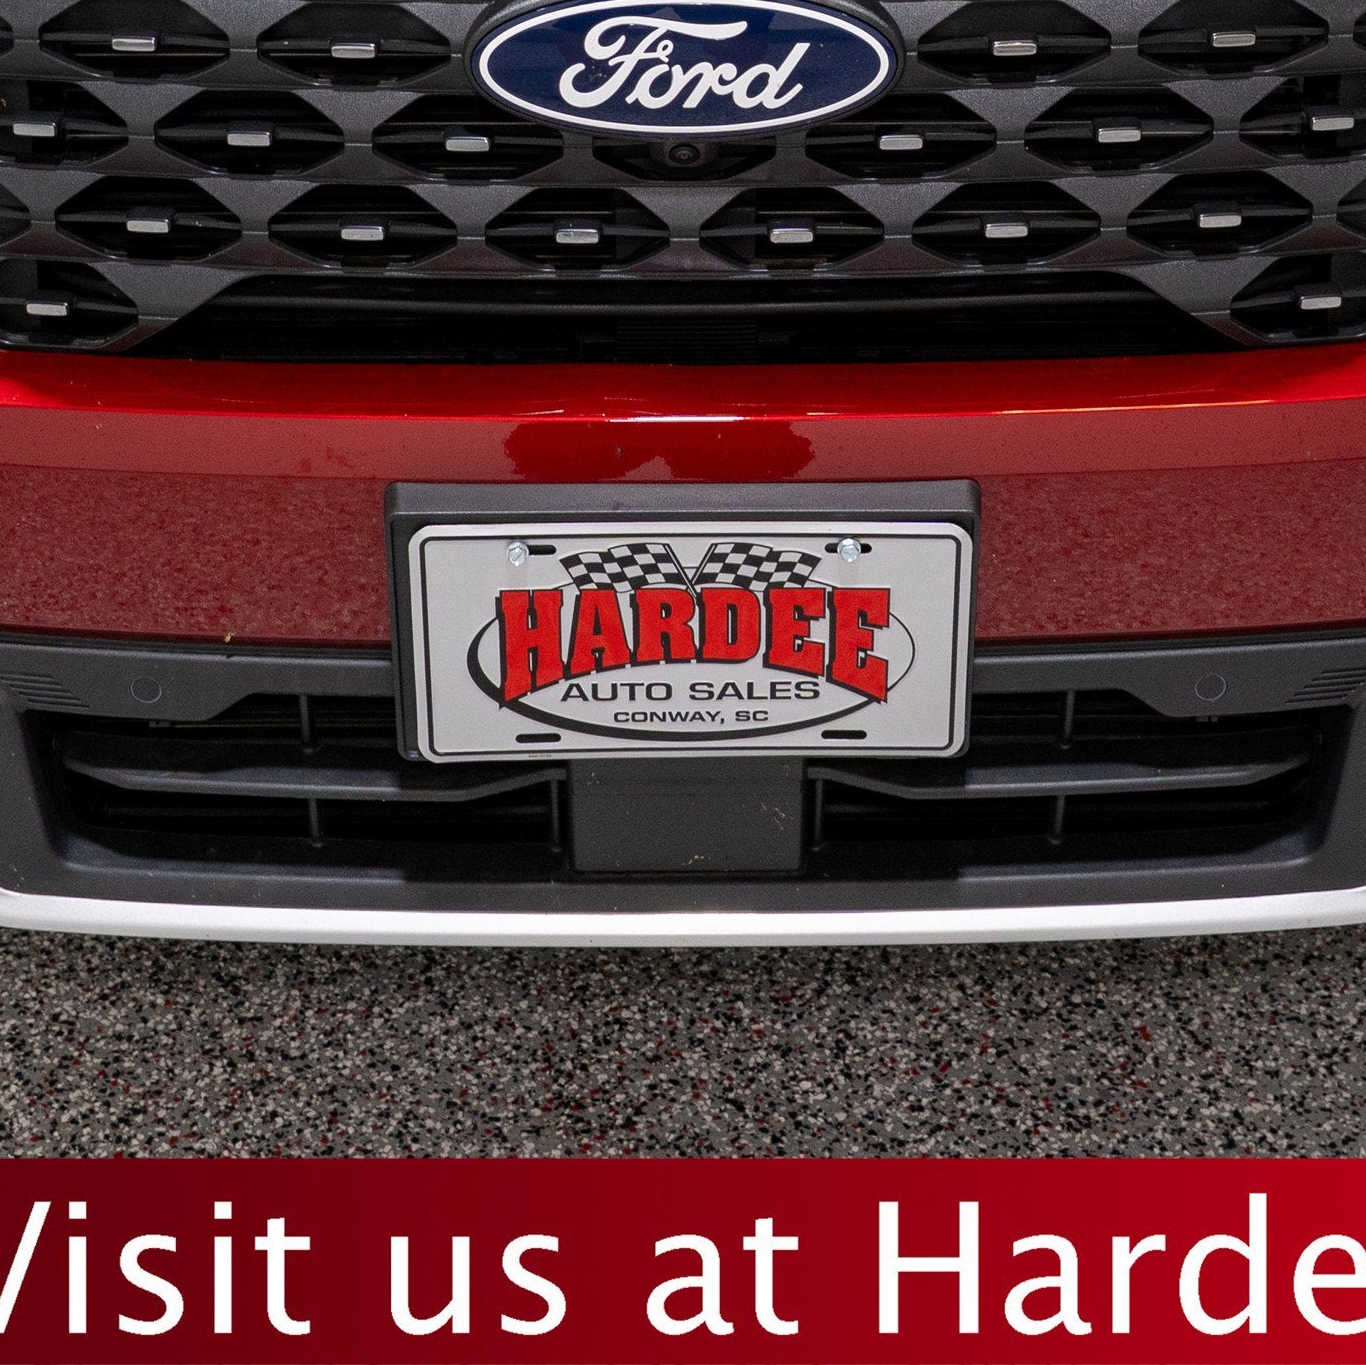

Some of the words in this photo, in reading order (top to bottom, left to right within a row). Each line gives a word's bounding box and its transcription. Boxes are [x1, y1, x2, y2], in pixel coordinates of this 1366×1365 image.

[558, 15, 811, 109] Ford
[496, 587, 891, 706] HARDEE
[560, 682, 673, 702] AUTO
[688, 680, 821, 701] SALES
[613, 710, 725, 724] CONWAY,
[735, 710, 769, 722] SC
